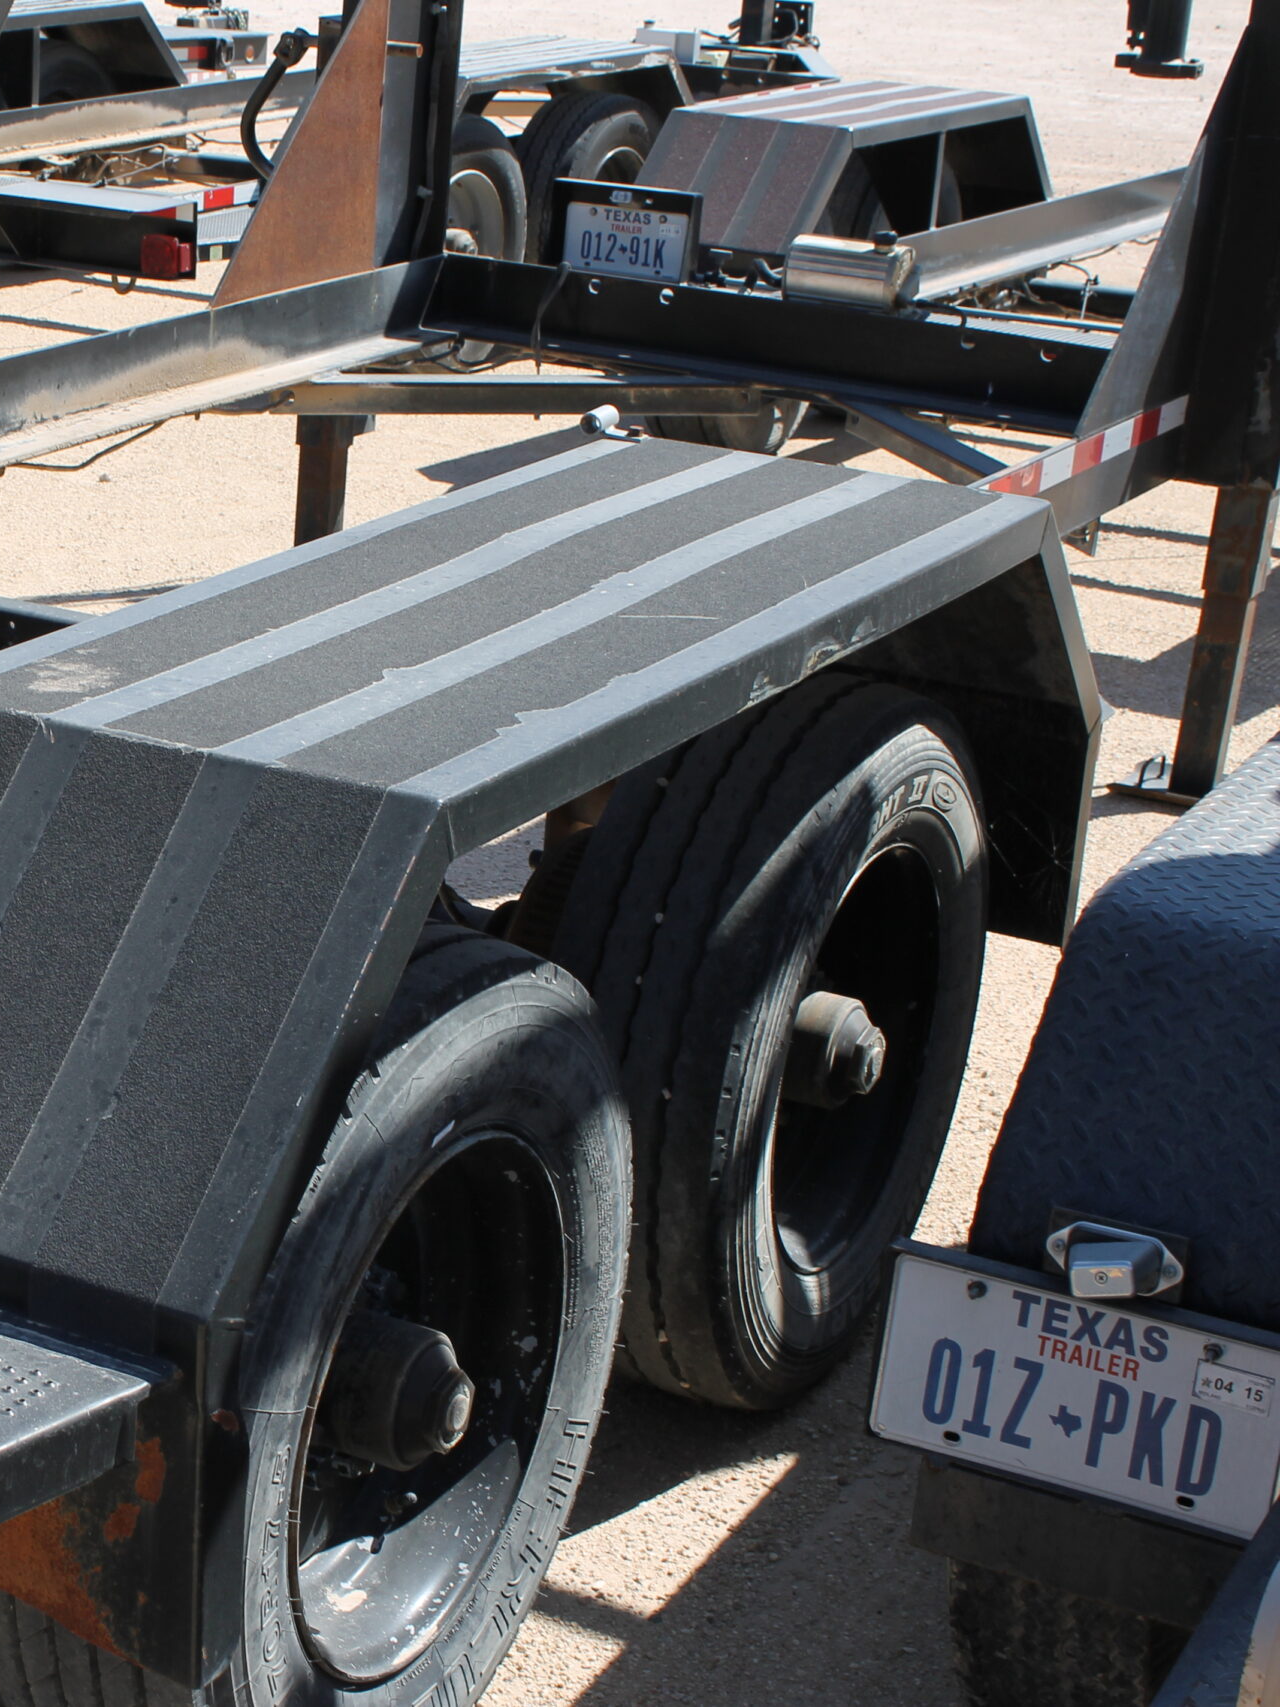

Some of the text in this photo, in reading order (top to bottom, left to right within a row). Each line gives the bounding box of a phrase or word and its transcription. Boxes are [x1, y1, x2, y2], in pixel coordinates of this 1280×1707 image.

[604, 208, 651, 225] TEXAS
[611, 223, 643, 234] TRAILER
[580, 230, 666, 269] 012 91K
[1013, 1290, 1169, 1363] TEXAS
[1037, 1334, 1141, 1382] TRAILER
[1214, 1378, 1234, 1394] 04
[1245, 1386, 1264, 1402] 15
[922, 1336, 1223, 1497] 01Z PKD
